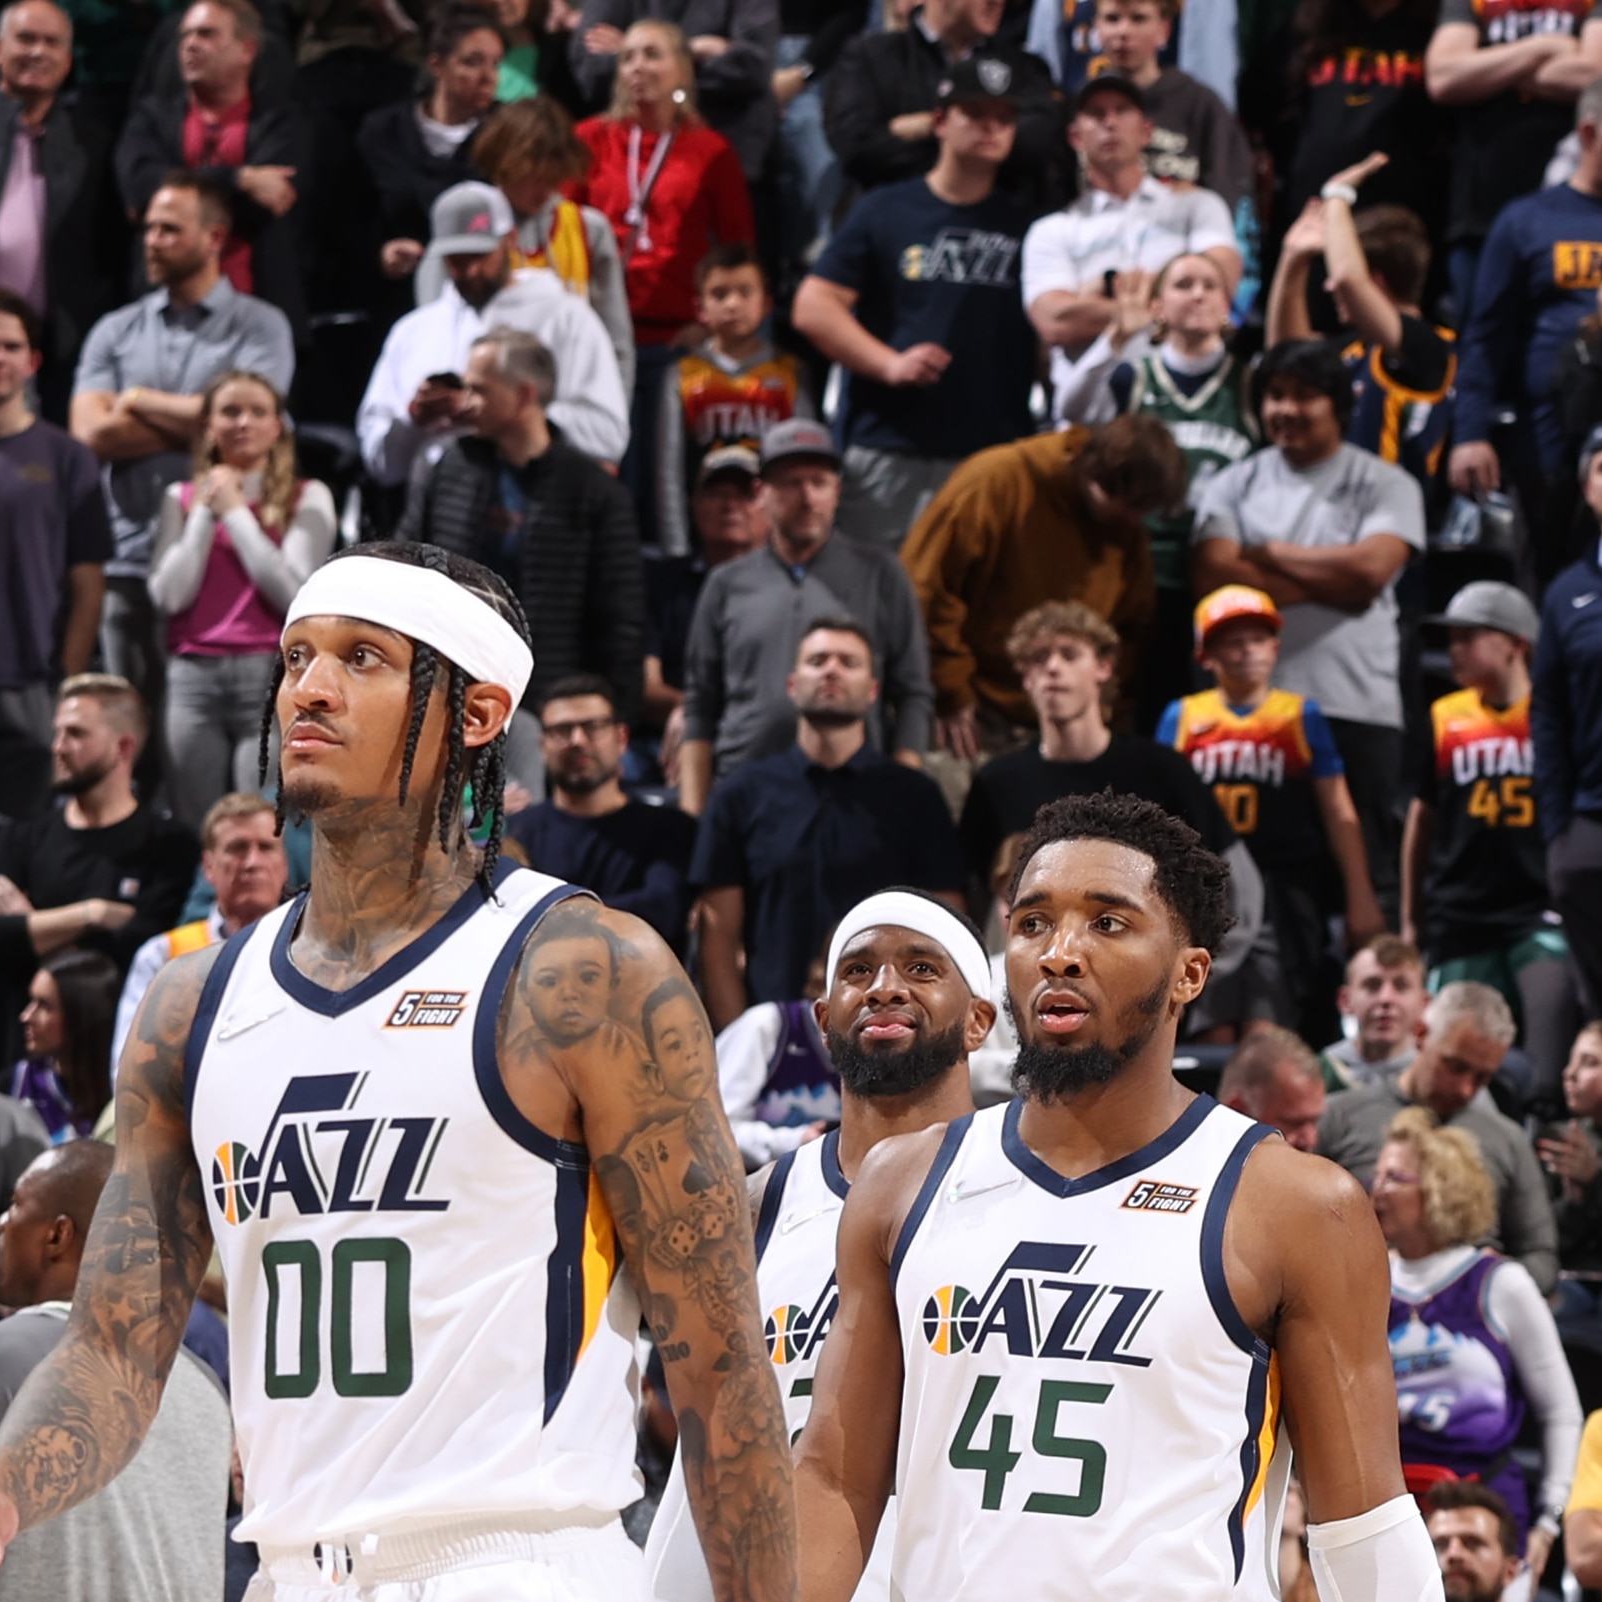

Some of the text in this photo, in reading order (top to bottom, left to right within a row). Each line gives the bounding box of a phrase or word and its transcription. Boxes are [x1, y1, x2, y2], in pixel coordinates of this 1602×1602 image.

[1465, 777, 1536, 828] 45
[391, 993, 422, 1026] 5
[412, 1009, 460, 1025] FIGHT
[213, 1070, 452, 1226] JAZZ
[1127, 1183, 1156, 1207] 5
[1147, 1197, 1192, 1212] FIGHT
[262, 1237, 415, 1400] 00
[922, 1240, 1165, 1368] JAZZ
[948, 1374, 1115, 1518] 45
